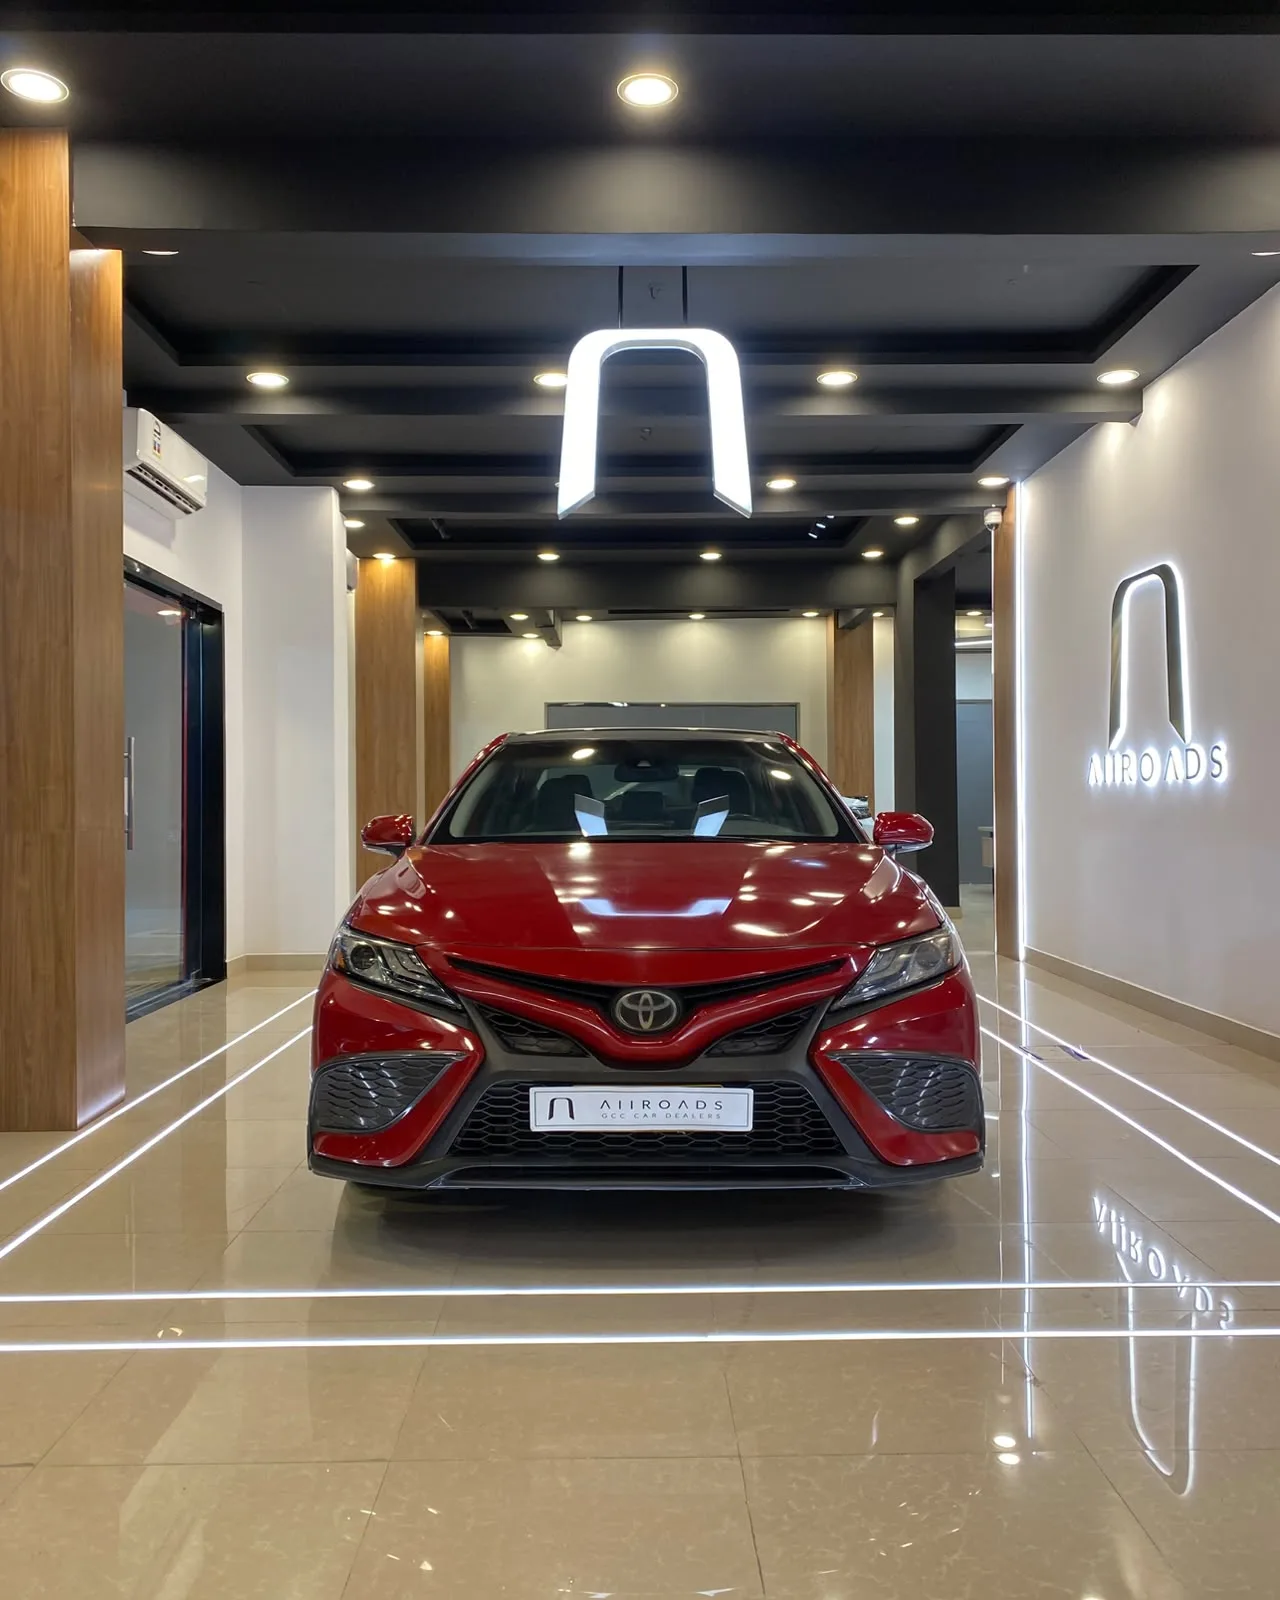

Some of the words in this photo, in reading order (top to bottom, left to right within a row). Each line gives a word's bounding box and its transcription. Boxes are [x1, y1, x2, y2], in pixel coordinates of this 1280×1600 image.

[600, 1099, 723, 1110] AIIROADS
[601, 1112, 625, 1120] GCC
[633, 1112, 657, 1120] CAR
[665, 1112, 721, 1120] DEALERS
